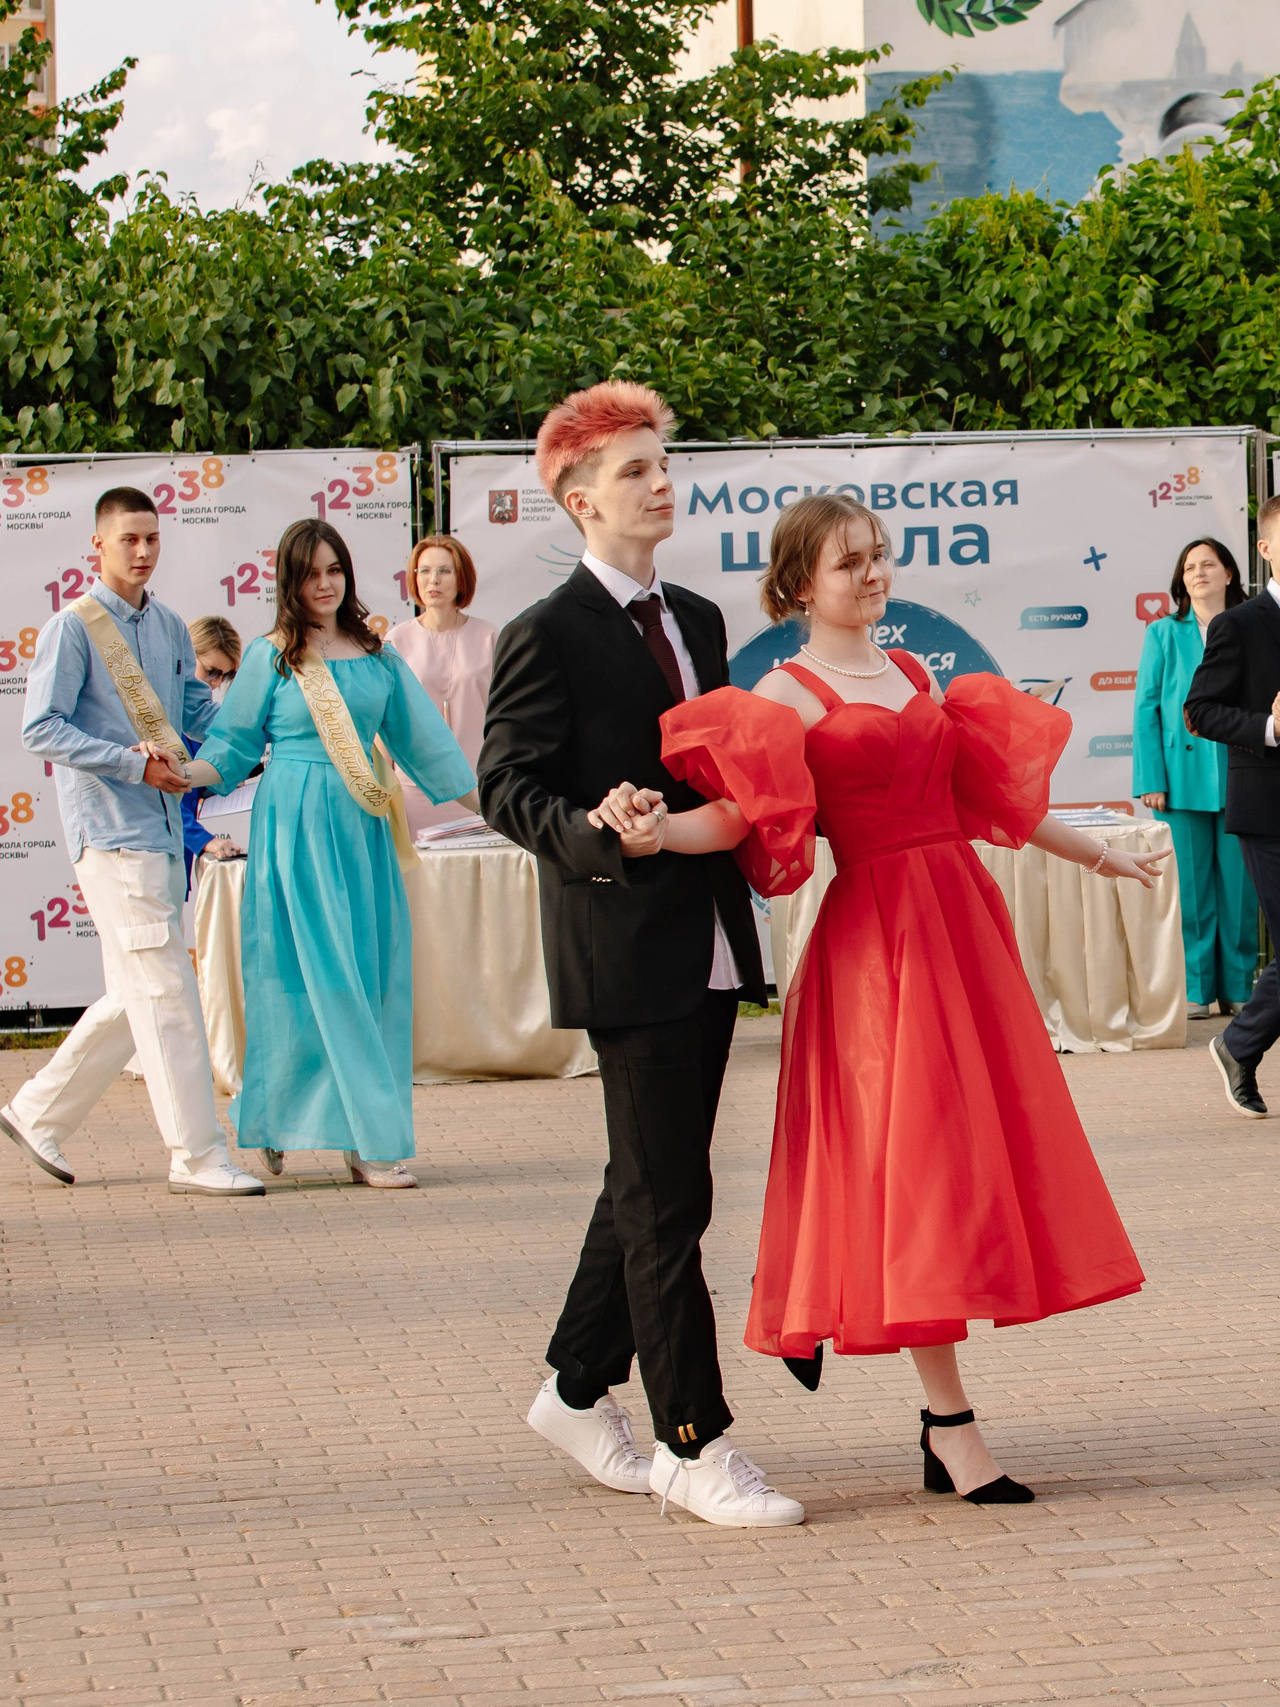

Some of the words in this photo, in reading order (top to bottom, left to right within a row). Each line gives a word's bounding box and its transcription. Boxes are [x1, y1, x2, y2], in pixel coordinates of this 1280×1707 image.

[2, 467, 50, 508] 38
[153, 457, 225, 514] 238
[311, 453, 398, 521] 1238
[1148, 466, 1200, 508] 1238
[182, 506, 212, 515] ШКОЛА
[213, 505, 246, 514] ГОРОДА
[356, 502, 385, 510] ШКОЛА
[6, 512, 37, 521] ШКОЛА
[38, 511, 72, 520] ГОРОДА
[182, 517, 219, 525] МОСКВЫ
[356, 512, 392, 520] МОСКВЫ
[6, 522, 44, 531] МОСКВЫ
[721, 523, 990, 572] шла
[220, 550, 276, 607] 123
[1050, 613, 1082, 621] РУЧКА?
[0, 627, 40, 672] 38
[311, 688, 370, 787] Выпускник
[23, 840, 56, 848] ГОРОДА
[0, 851, 29, 859] ОСКВЫ
[30, 884, 90, 941] 123
[76, 920, 95, 928] ШКО
